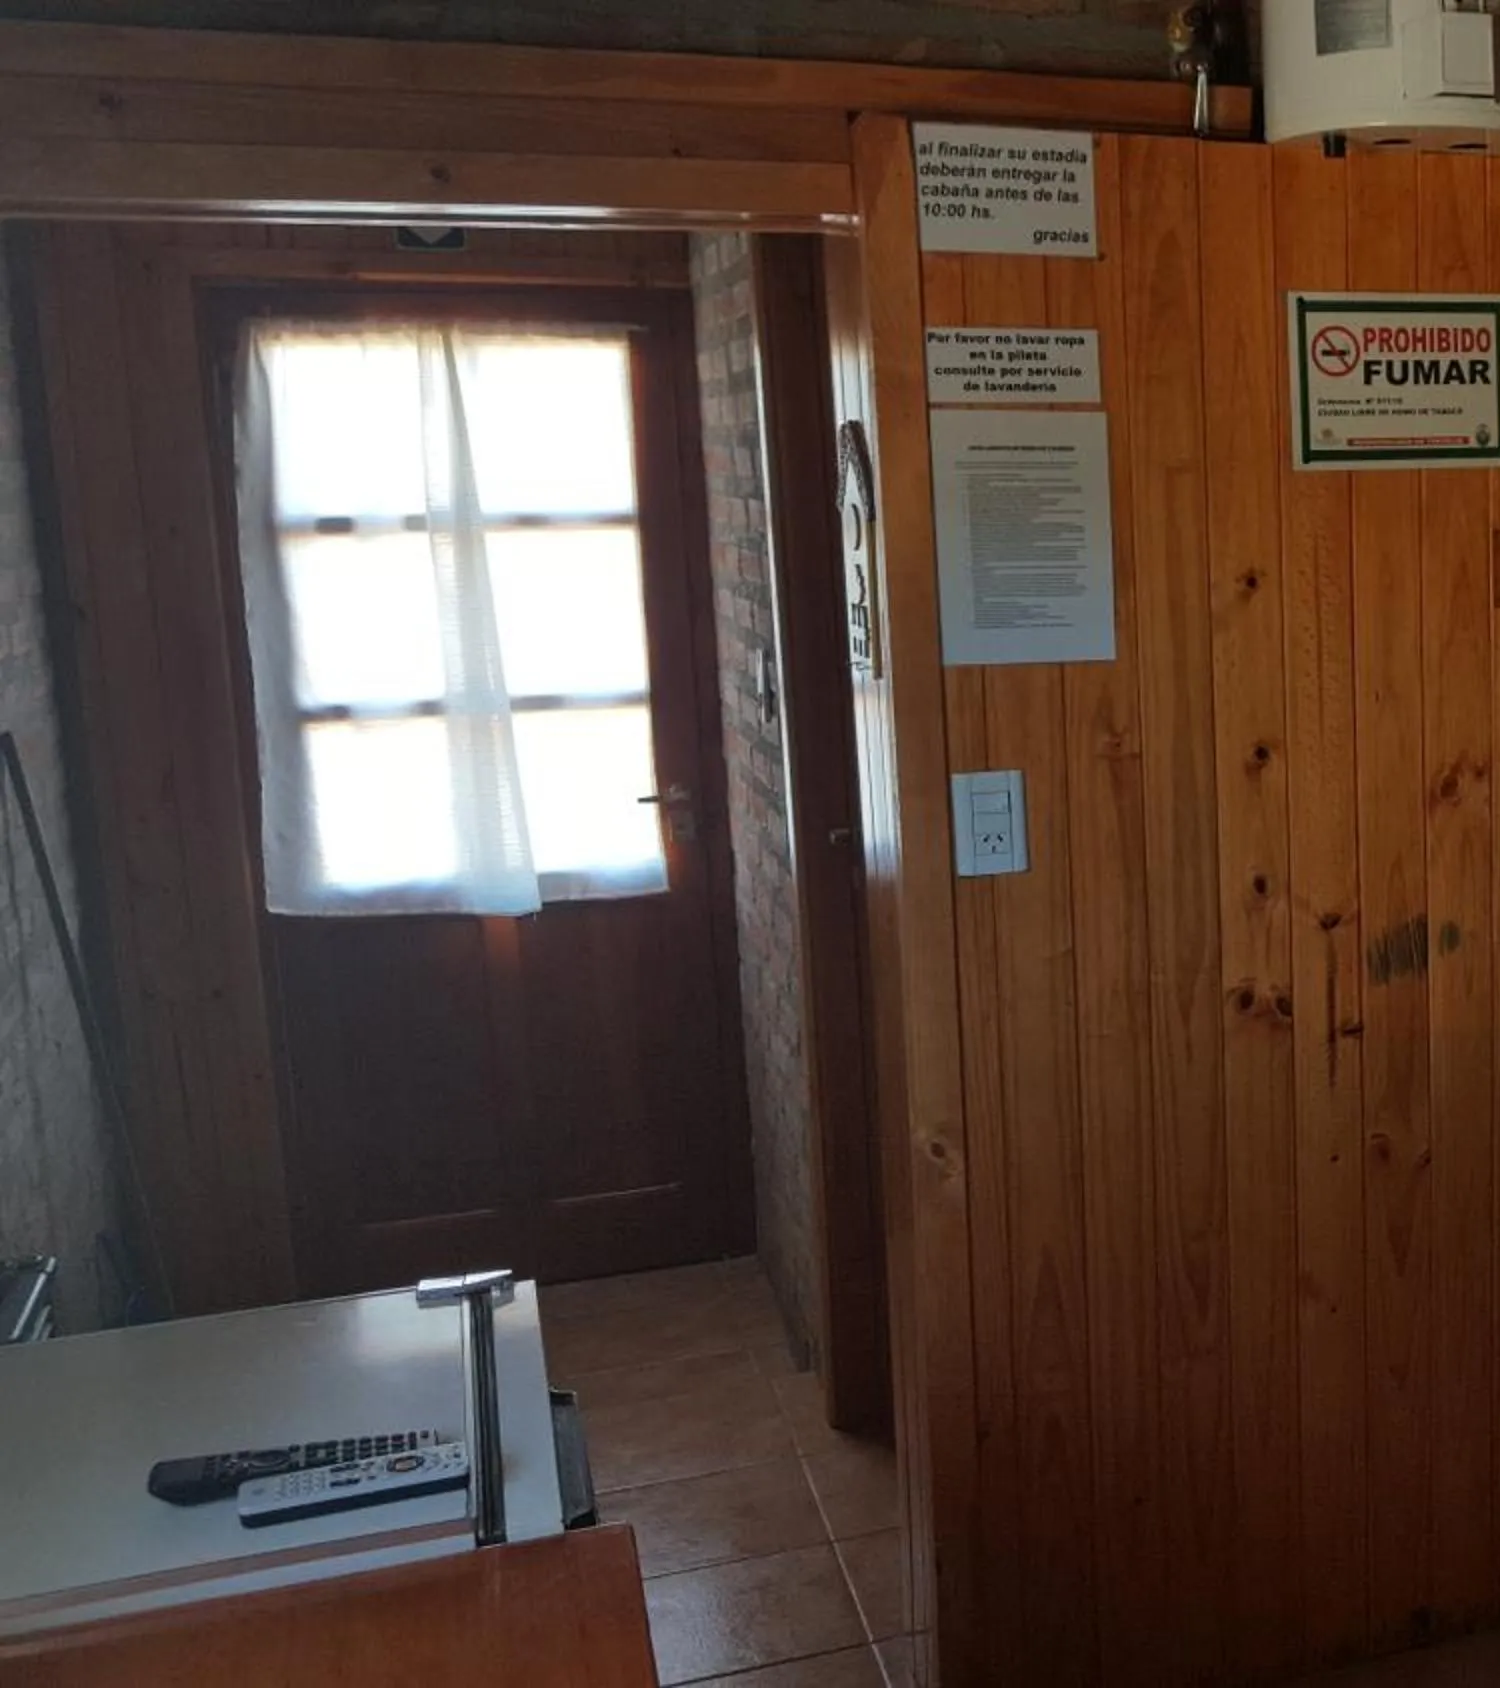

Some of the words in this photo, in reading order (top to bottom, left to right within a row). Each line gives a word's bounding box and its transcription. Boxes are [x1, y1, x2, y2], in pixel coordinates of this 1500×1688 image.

[919, 143, 933, 155] al
[938, 142, 1003, 159] finalizar
[1007, 148, 1027, 160] su
[991, 167, 1058, 185] entregar
[1063, 168, 1076, 183] la
[921, 183, 980, 198] cabaña
[985, 187, 1028, 200] antes
[1033, 188, 1053, 202] de
[1057, 189, 1080, 203] las
[923, 203, 966, 217] 10:00
[970, 204, 996, 219] hs.
[1032, 229, 1090, 245] gracias
[927, 332, 950, 343] Por
[954, 333, 990, 345] favor
[995, 335, 1013, 345] no
[1016, 334, 1050, 345] lavar
[1054, 335, 1085, 348] ropa
[1363, 327, 1491, 353] PROHIBIDO
[969, 351, 987, 361] en
[991, 350, 1004, 361] la
[1007, 350, 1047, 362] pileta
[934, 365, 996, 377] consulte
[1000, 366, 1022, 378] por
[1027, 365, 1082, 377] servicio
[1363, 359, 1491, 385] FUMAR
[963, 381, 980, 391] de
